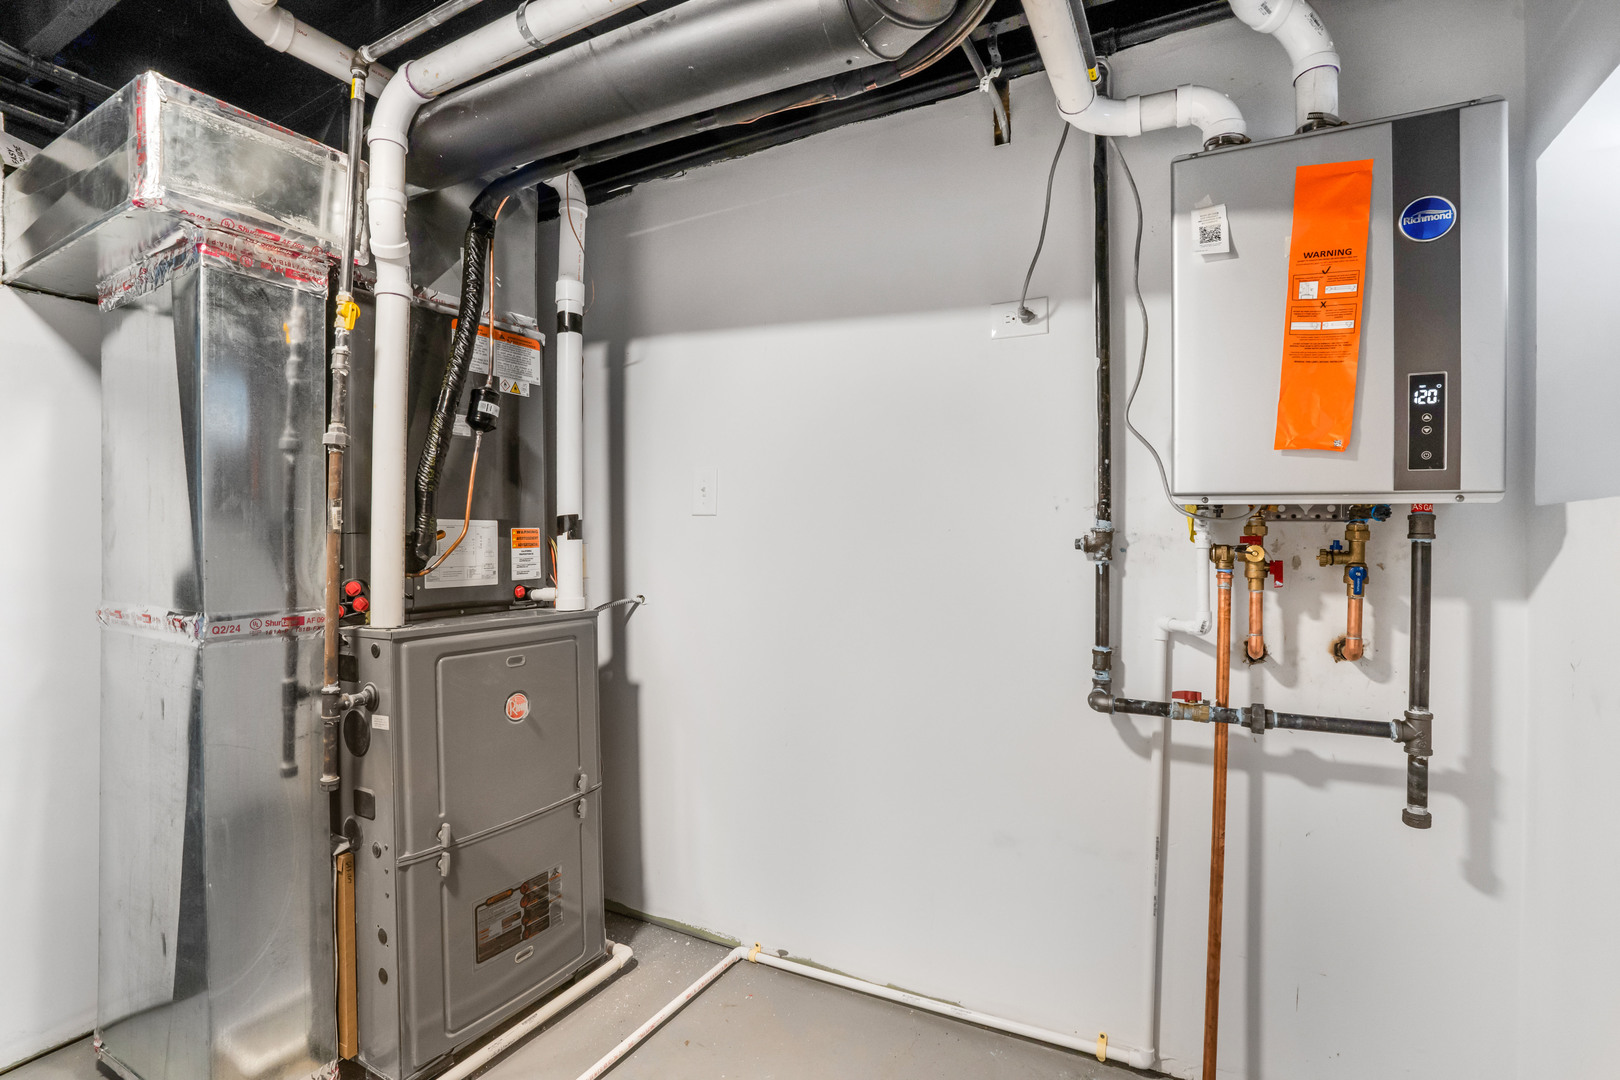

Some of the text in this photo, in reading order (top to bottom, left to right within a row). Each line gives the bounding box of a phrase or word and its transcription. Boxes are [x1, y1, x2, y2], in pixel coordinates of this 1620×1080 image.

[1403, 210, 1452, 226] Richmond
[1304, 248, 1352, 258] WARNING
[1414, 388, 1438, 404] 120
[212, 624, 241, 635] Q2/24
